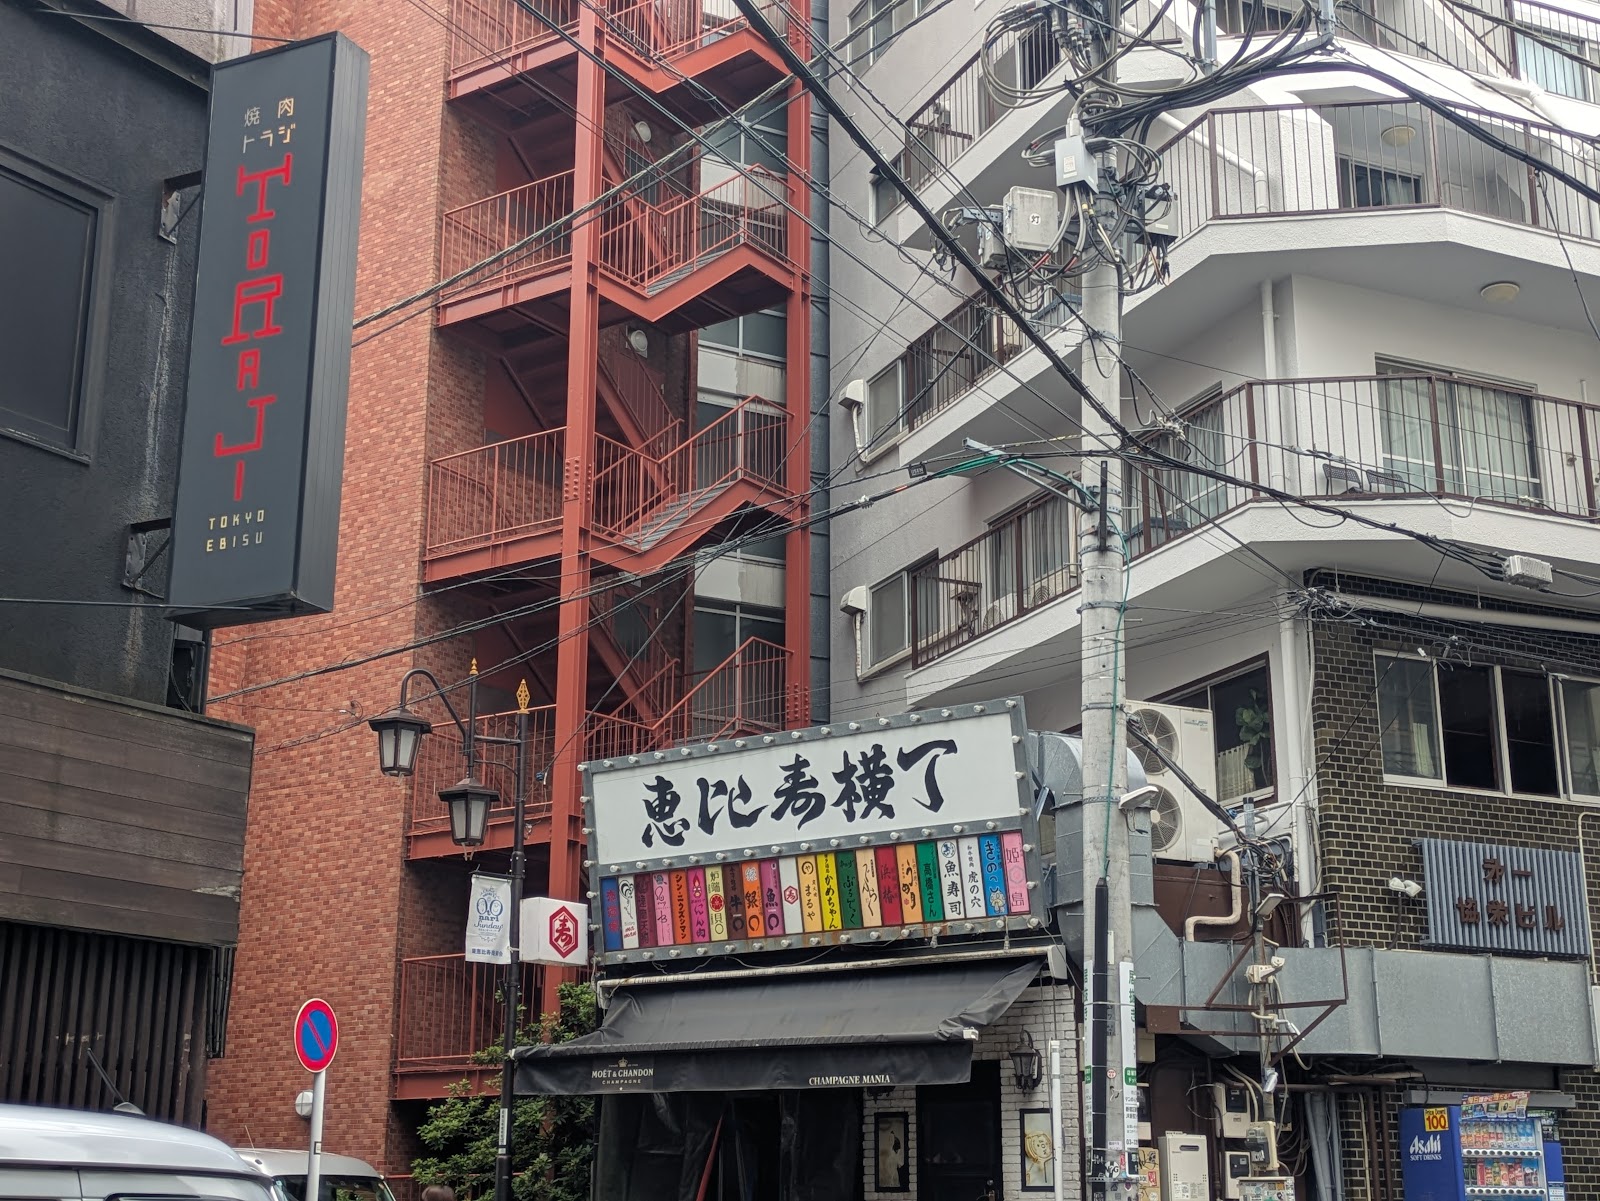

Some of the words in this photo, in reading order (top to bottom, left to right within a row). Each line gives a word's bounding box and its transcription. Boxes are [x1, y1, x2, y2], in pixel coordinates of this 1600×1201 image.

[244, 98, 294, 127] 焼肉
[242, 123, 296, 153] トラジ
[208, 509, 265, 530] TOKYO
[206, 531, 263, 552] EBISU
[642, 740, 958, 848] 恵比寿横丁
[985, 840, 999, 893] きのこ
[805, 884, 816, 921] まるや
[825, 874, 838, 929] かめちゃん
[923, 863, 937, 918] 高橋さん
[944, 860, 962, 916] 魚寿司
[968, 871, 982, 909] 虎の穴
[618, 1068, 654, 1077] CHANDON
[809, 1076, 861, 1086] CHAMPAGNE
[862, 1074, 890, 1084] MANIA
[1426, 1114, 1446, 1130] 100
[1409, 1134, 1441, 1154] Asahi
